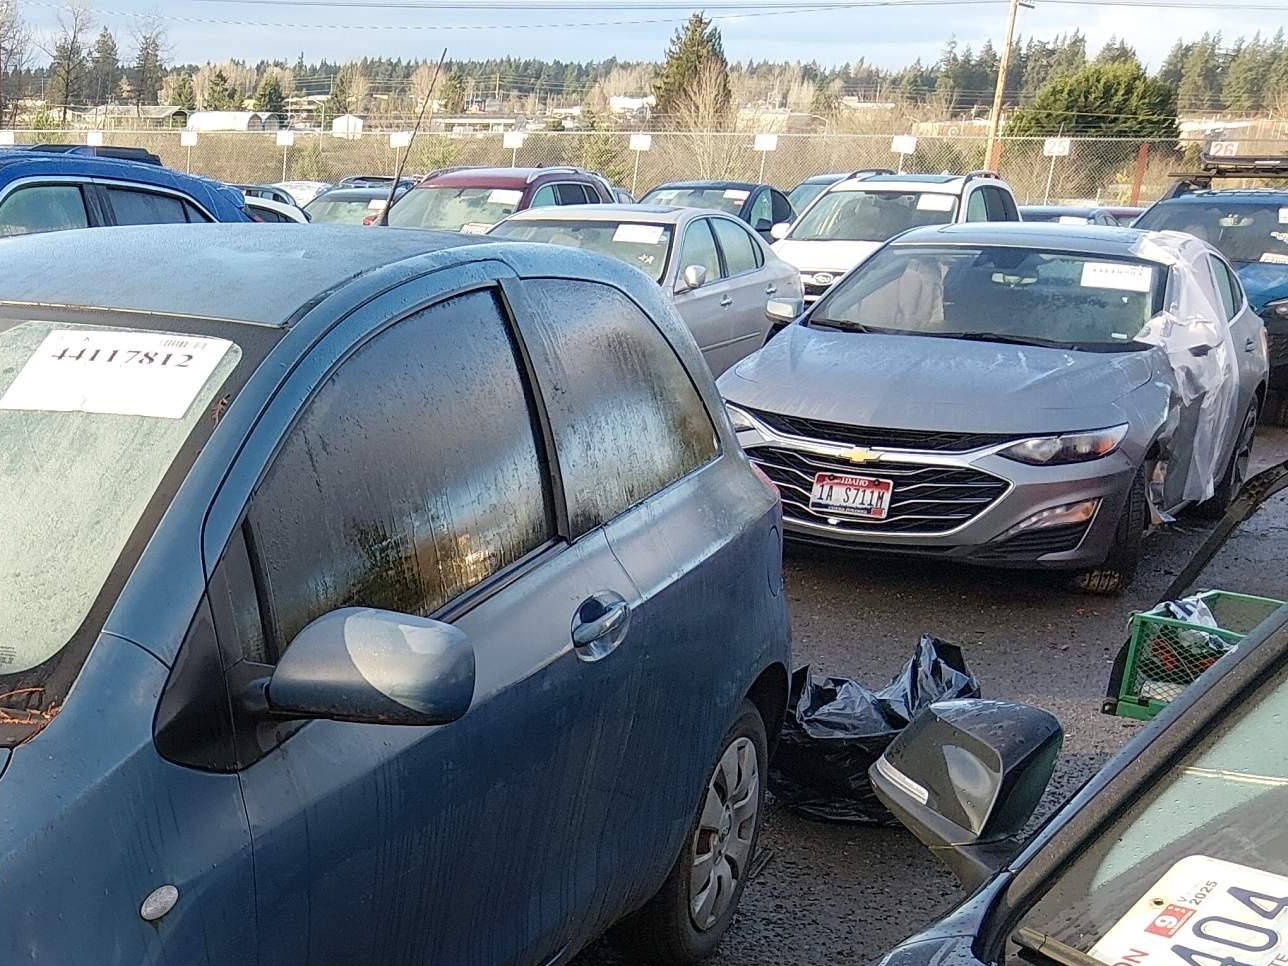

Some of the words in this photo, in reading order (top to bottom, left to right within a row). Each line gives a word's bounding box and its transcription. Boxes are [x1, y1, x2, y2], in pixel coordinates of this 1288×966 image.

[1214, 142, 1235, 155] 26
[51, 347, 194, 368] 44117812
[839, 476, 869, 487] IDAHO
[816, 483, 834, 502] 1A
[1188, 880, 1218, 906] 2025
[1154, 914, 1179, 932] 9
